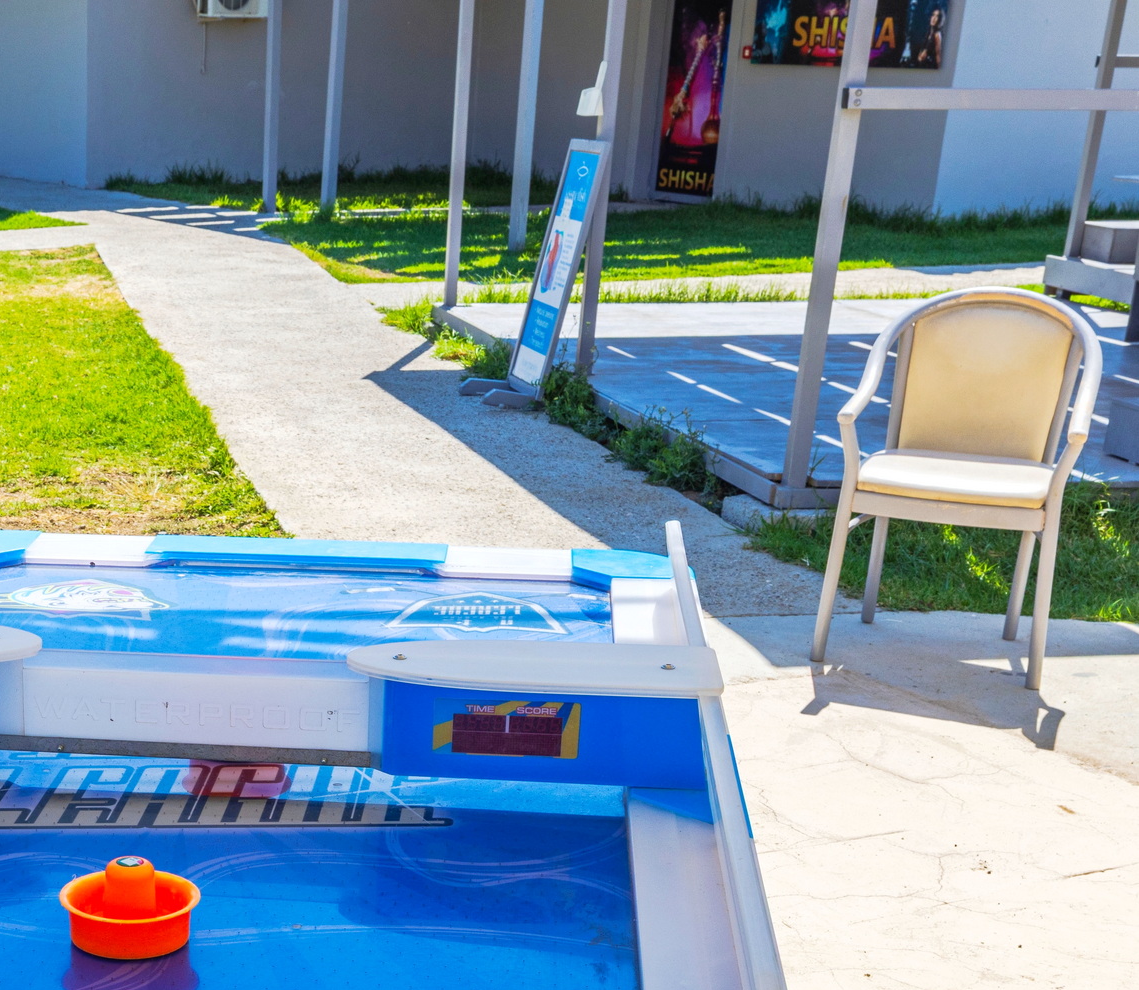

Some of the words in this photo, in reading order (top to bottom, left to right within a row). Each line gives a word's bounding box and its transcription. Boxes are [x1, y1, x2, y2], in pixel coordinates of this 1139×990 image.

[792, 16, 896, 48] SHISA
[33, 696, 361, 733] WATERPROOF
[466, 704, 495, 713] TIME
[516, 706, 557, 716] SCORE
